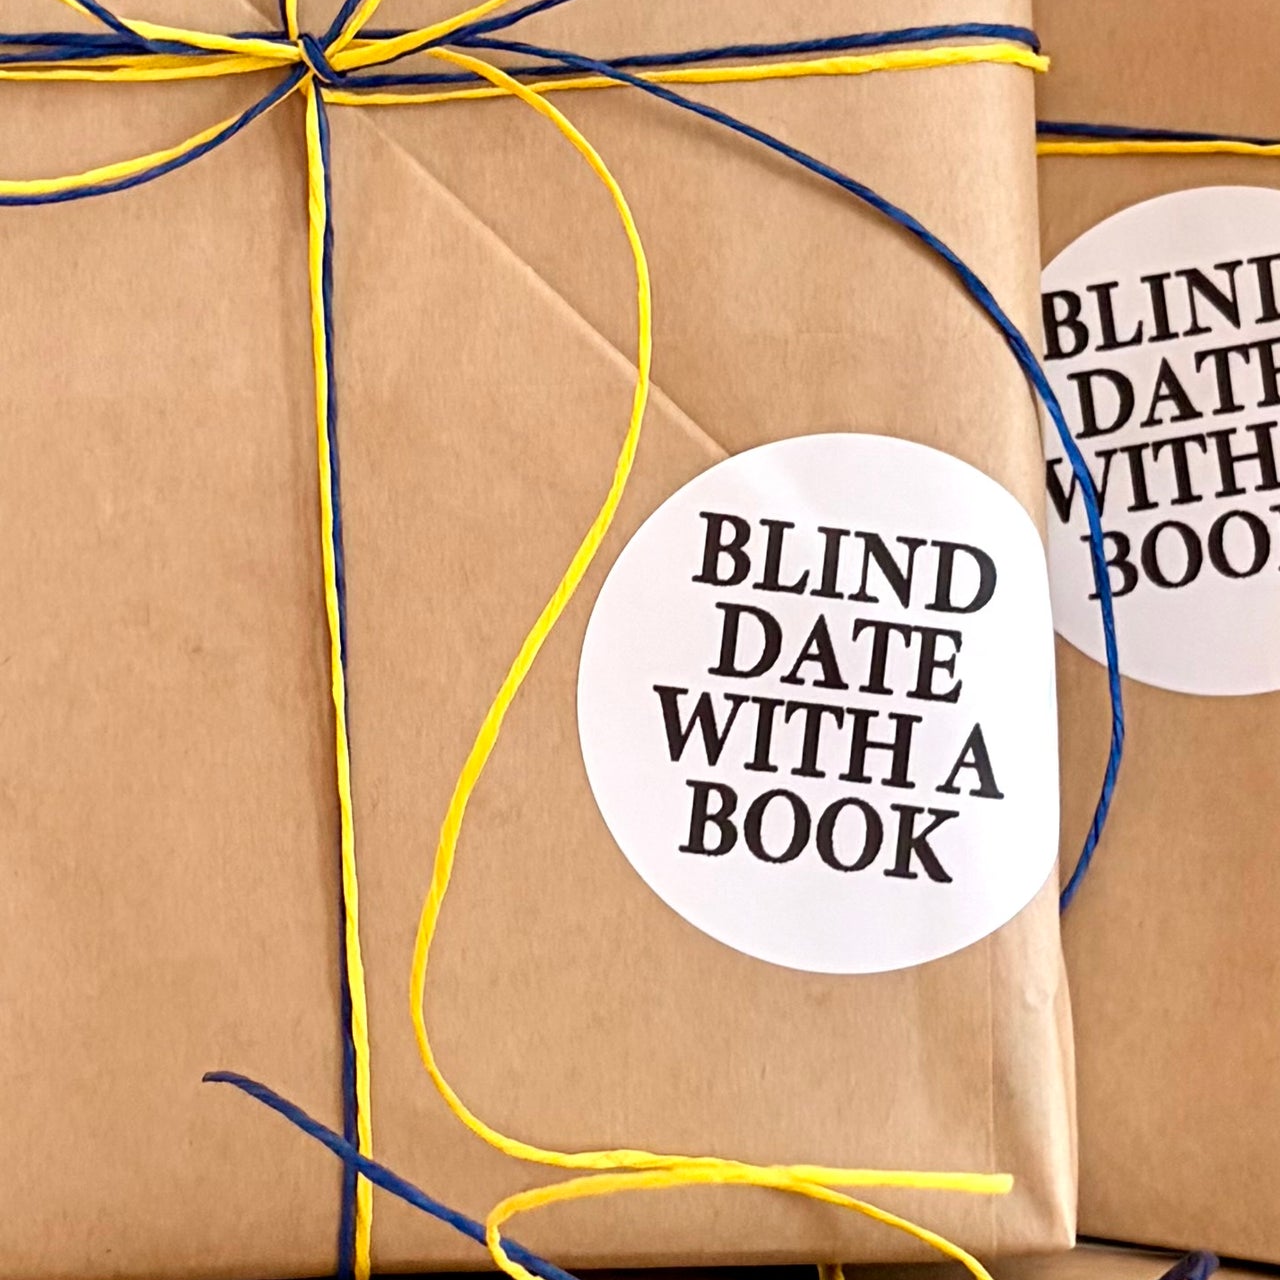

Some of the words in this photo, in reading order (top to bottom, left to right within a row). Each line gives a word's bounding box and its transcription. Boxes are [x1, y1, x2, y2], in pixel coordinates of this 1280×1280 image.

[691, 511, 997, 614] BLIND
[708, 601, 962, 704] DATE
[652, 684, 923, 789] WITH
[935, 722, 1004, 799] A
[678, 779, 960, 883] BOOK
